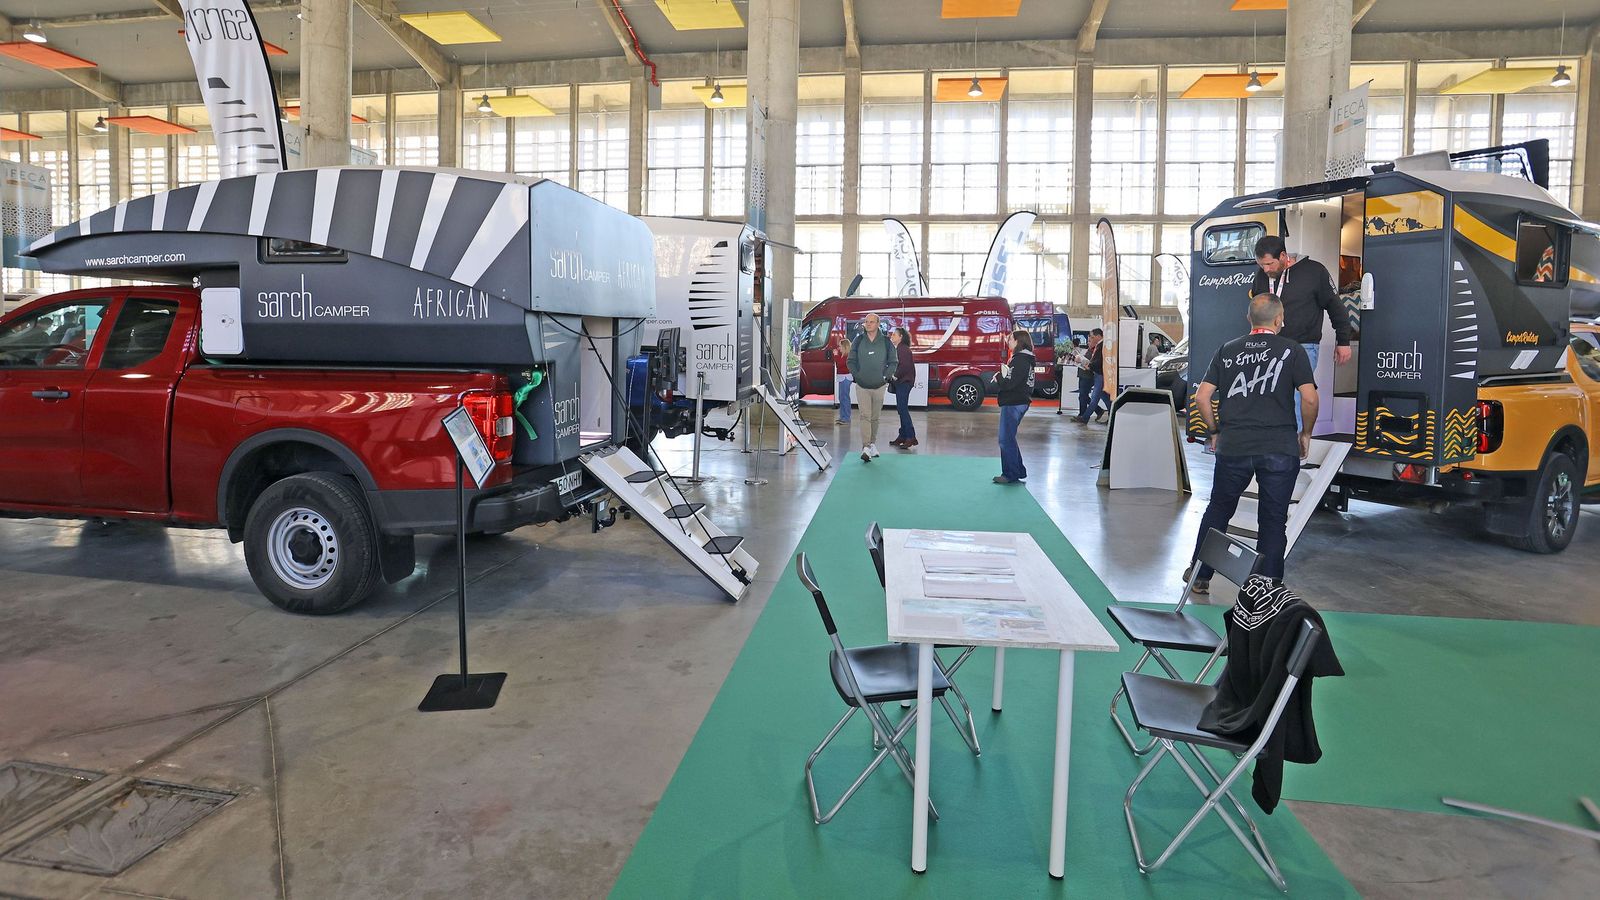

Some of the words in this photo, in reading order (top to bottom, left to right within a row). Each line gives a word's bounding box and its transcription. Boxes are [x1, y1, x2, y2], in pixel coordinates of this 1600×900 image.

[1333, 97, 1365, 124] IFECA
[84, 252, 186, 267] www.sarchcamper.com
[257, 273, 312, 321] sarch
[314, 305, 370, 317] CAMPER
[413, 286, 489, 320] AFRICAN
[696, 332, 734, 363] sarch
[1376, 340, 1423, 372] sarch
[695, 362, 734, 371] CAMPER
[1226, 348, 1291, 399] AHÍ
[1376, 370, 1422, 380] CAMPER
[554, 381, 580, 426] sarch
[555, 423, 580, 440] CAMPER
